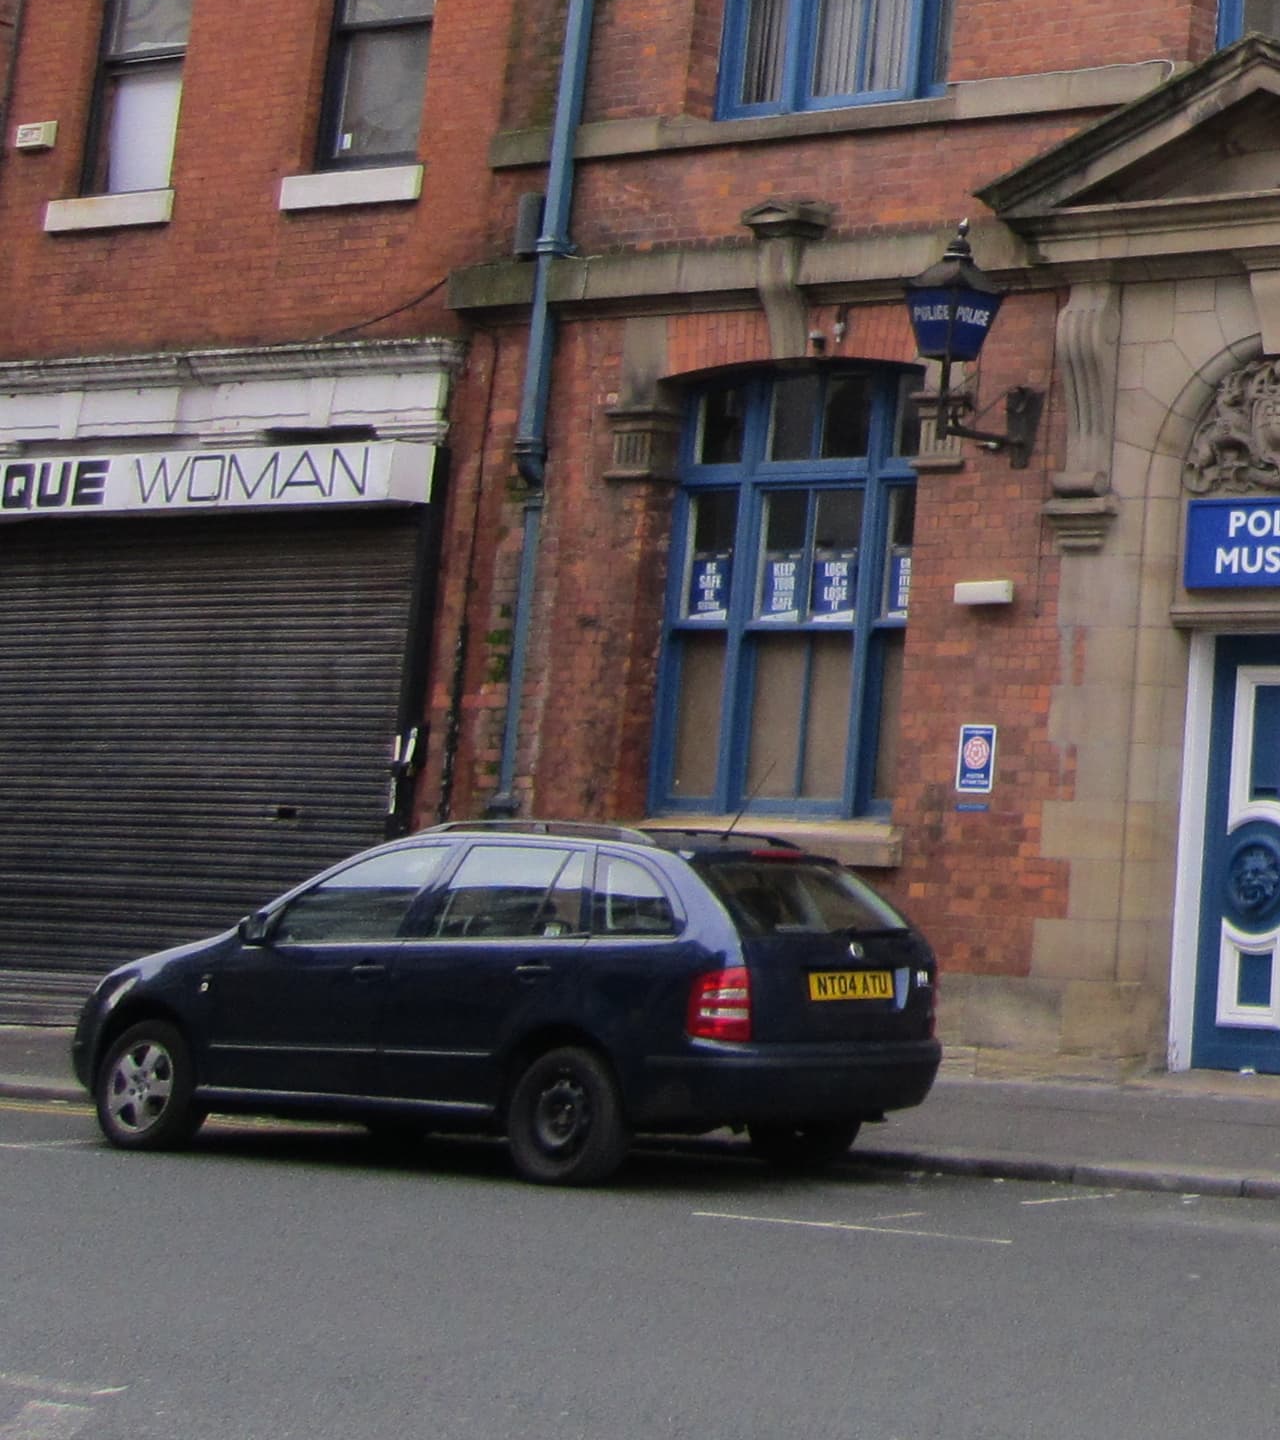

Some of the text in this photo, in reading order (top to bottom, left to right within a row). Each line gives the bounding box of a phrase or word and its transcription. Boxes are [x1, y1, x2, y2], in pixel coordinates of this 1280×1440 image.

[913, 305, 950, 321] POLICE
[955, 306, 990, 327] POLICE
[0, 446, 370, 510] QUE WOMAN
[773, 562, 796, 576] KEEP
[824, 562, 848, 576] LOCK
[699, 575, 722, 589] SAFE
[824, 587, 848, 601] LOSE
[771, 598, 792, 611] SAFE
[817, 974, 888, 996] NT04 ATU
